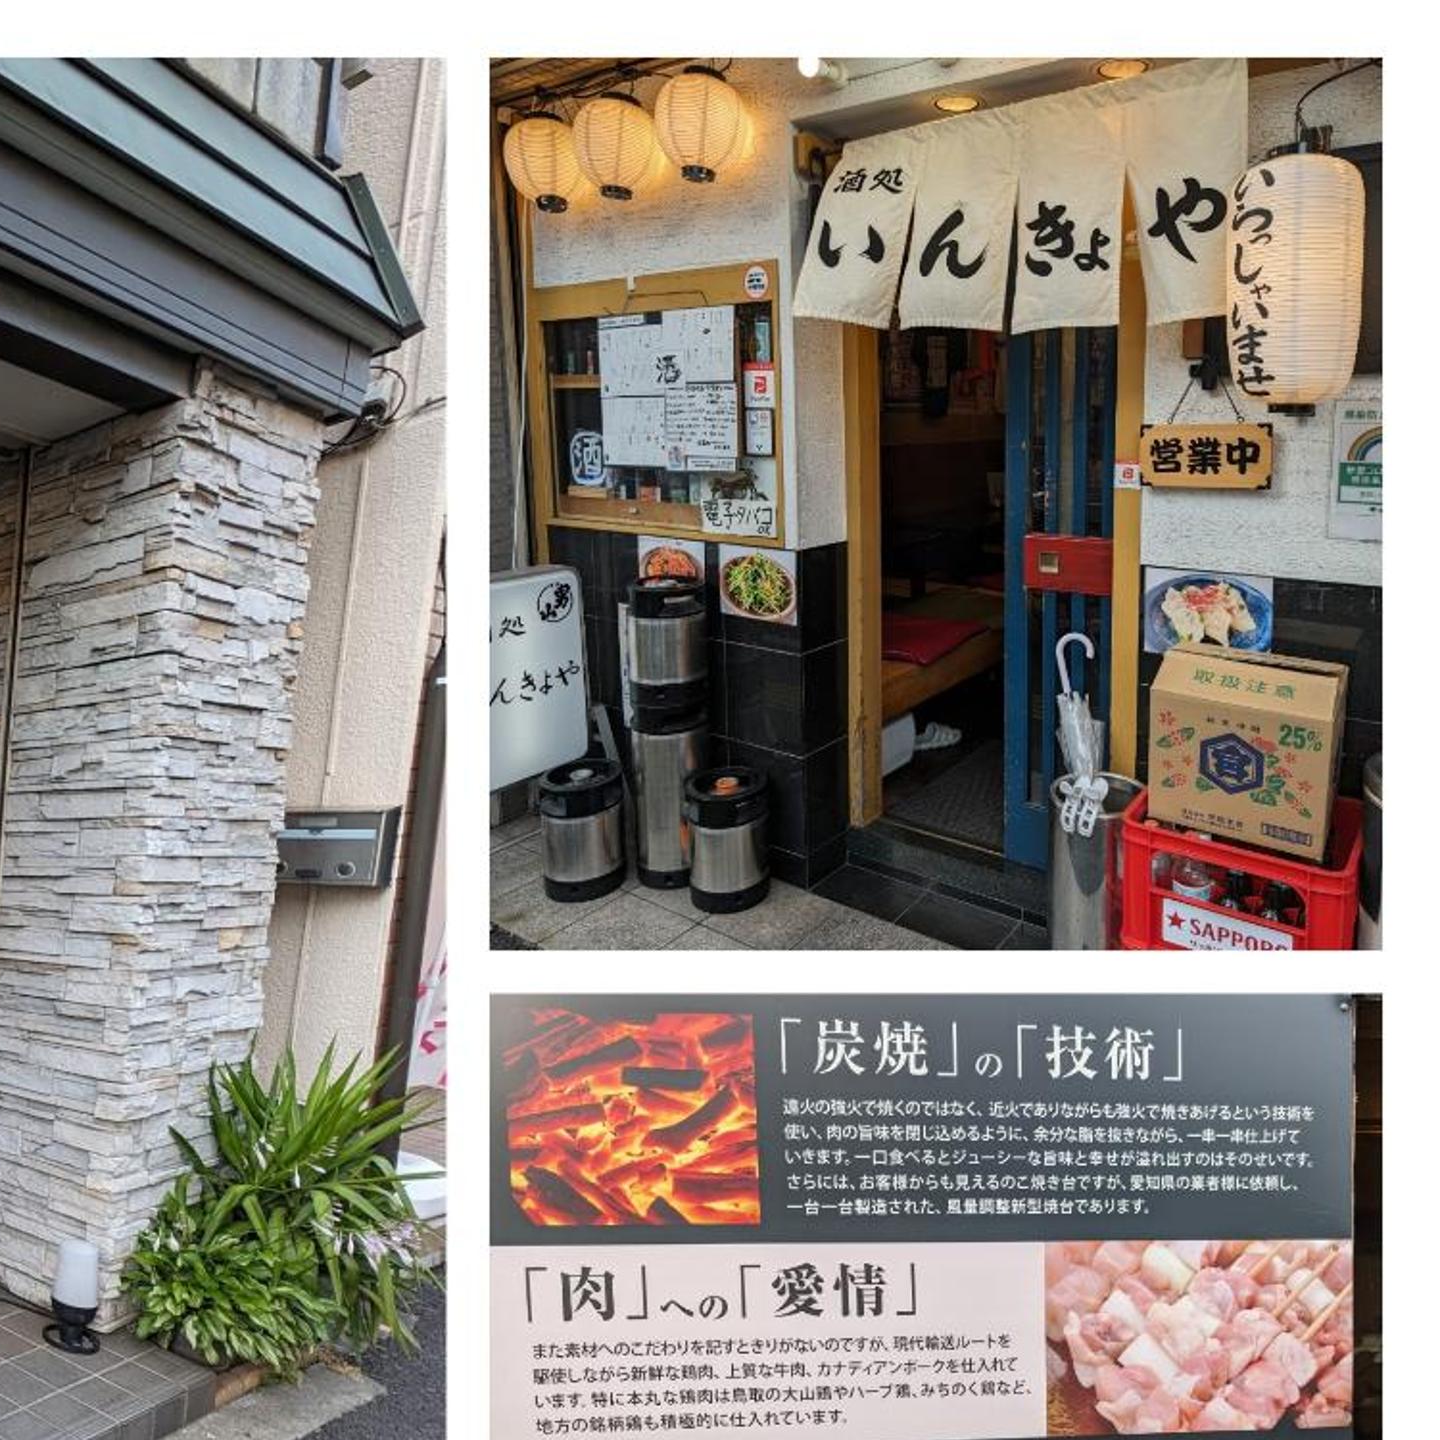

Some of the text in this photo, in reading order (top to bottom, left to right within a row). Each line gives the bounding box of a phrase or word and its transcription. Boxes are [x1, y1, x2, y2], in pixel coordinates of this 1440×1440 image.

[833, 167, 904, 194] 酒処
[817, 177, 1228, 280] いんきょや
[1231, 167, 1276, 398] いらっしゃいませ
[1149, 437, 1261, 476] 営業中
[490, 616, 526, 642] 処
[1278, 723, 1322, 752] 25%
[780, 1017, 1182, 1082] 「炭焼」の「技術」
[525, 1262, 917, 1323] 「肉」への「愛情」
